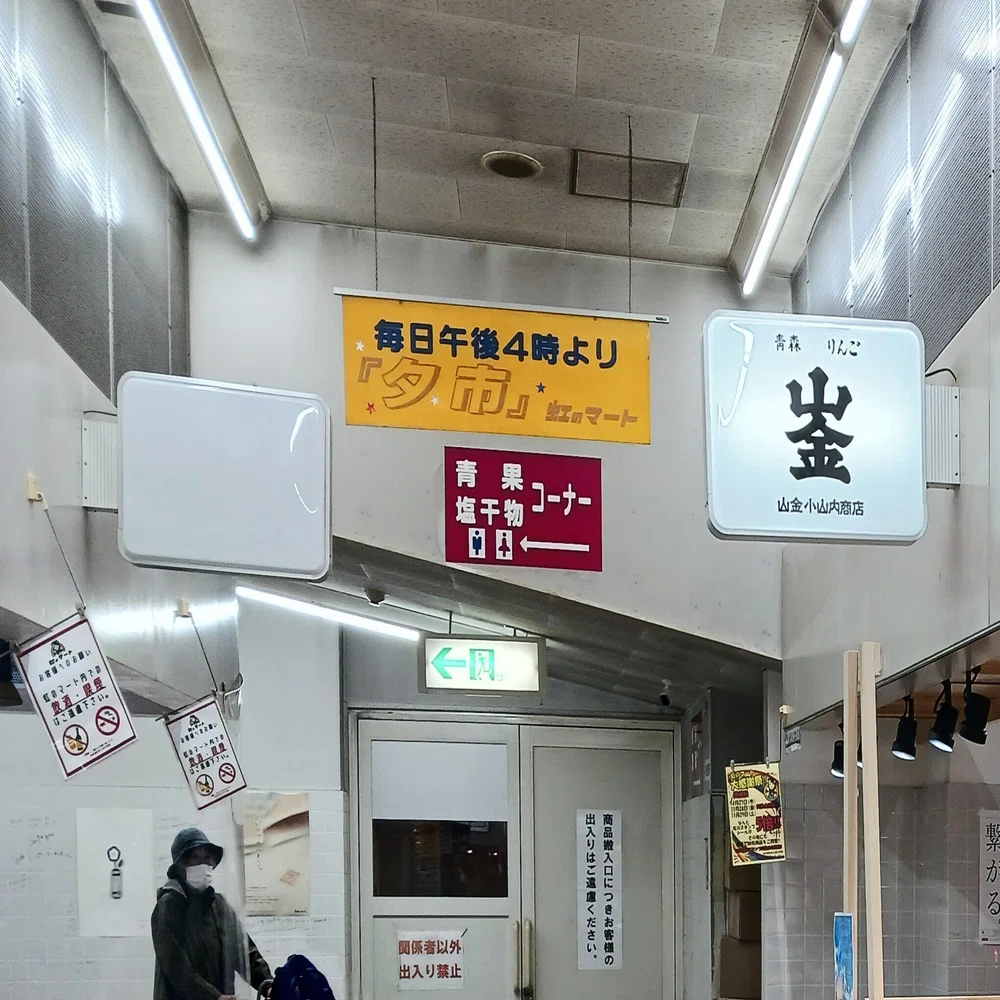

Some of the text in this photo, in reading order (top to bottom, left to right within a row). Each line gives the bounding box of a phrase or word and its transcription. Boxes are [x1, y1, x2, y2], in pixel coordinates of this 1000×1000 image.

[374, 319, 618, 369] 毎日午後4時より
[774, 333, 861, 356] 青森 りんご
[545, 400, 638, 427] 虹のマート
[455, 459, 523, 490] 青果
[455, 496, 524, 528] 塩干物
[531, 483, 592, 516] コーナー
[777, 497, 864, 516] 山金小山内商店
[585, 813, 598, 959] 出入りはご遠慮ください。
[603, 813, 614, 966] 商品搬入口につきお客様の
[398, 939, 461, 956] 関係者以外
[399, 963, 462, 980] 出入り禁止
